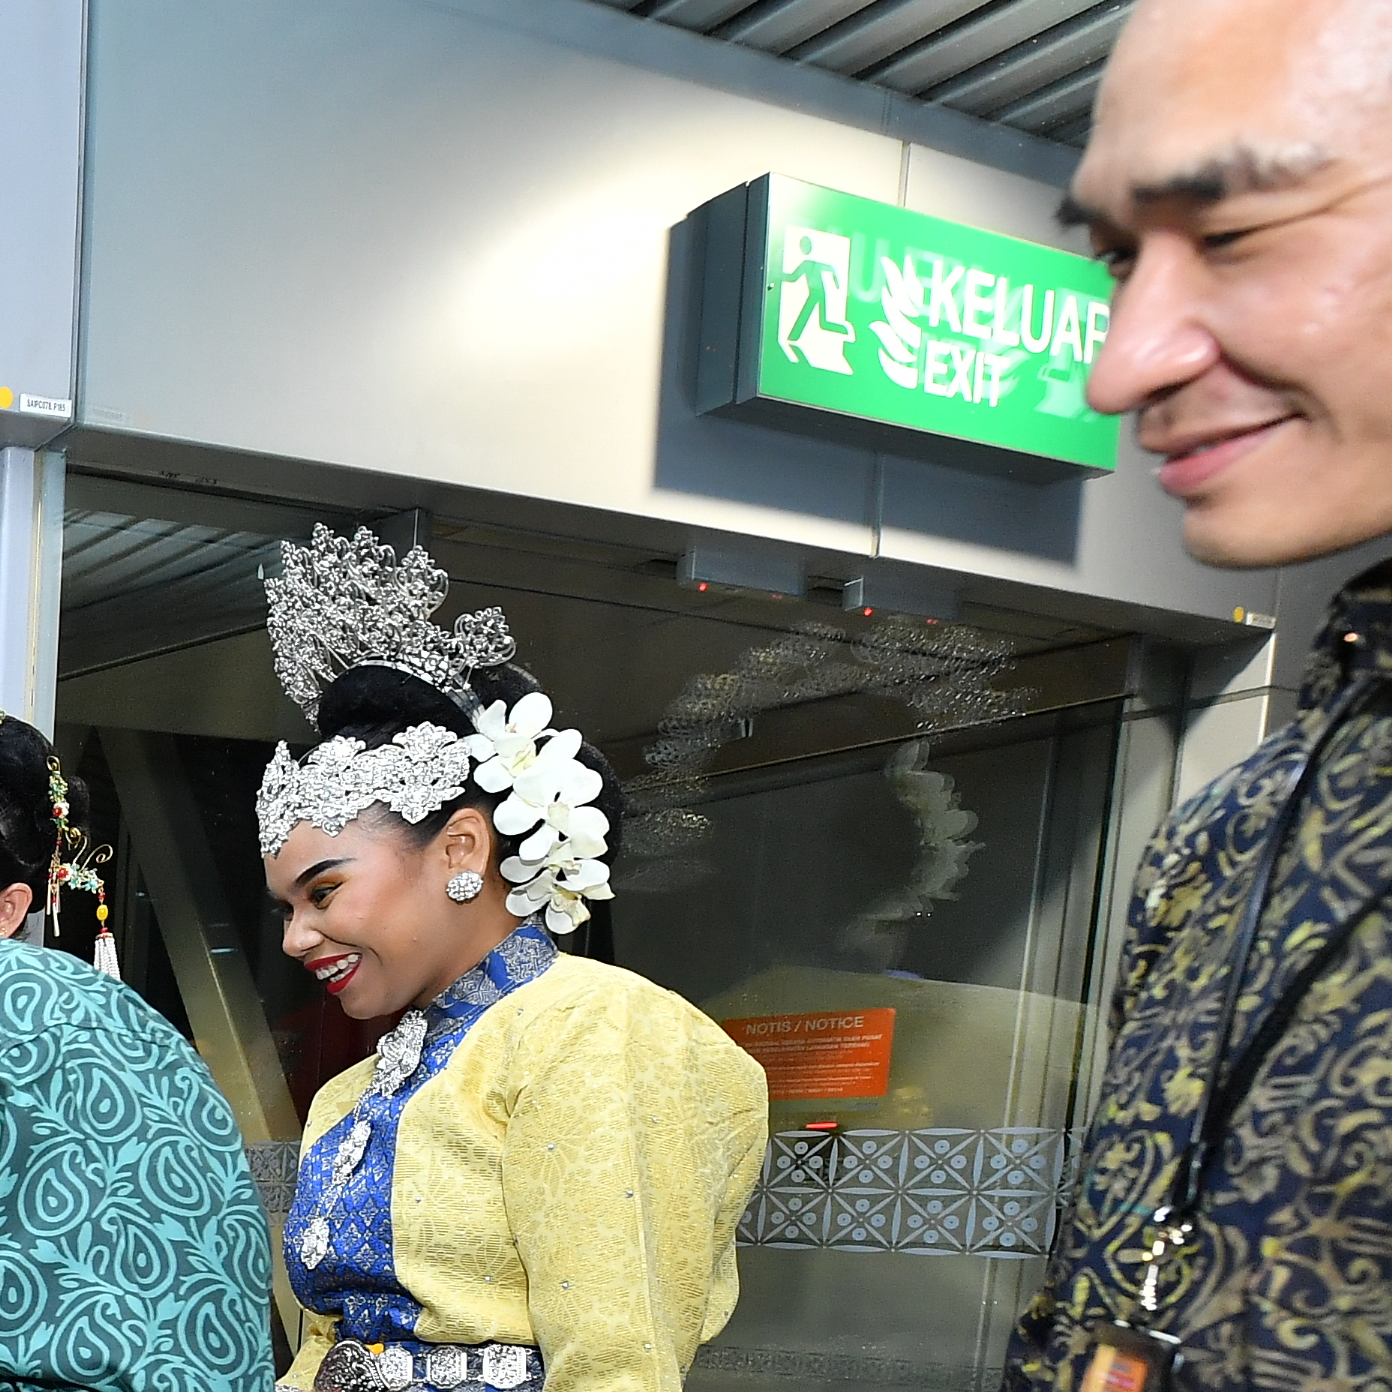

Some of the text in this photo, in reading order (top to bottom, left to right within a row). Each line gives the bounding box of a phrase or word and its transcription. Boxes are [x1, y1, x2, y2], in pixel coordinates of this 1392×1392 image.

[923, 339, 1011, 408] EXIT
[746, 1021, 791, 1035] NOTIS
[805, 1015, 865, 1032] NOTICE
